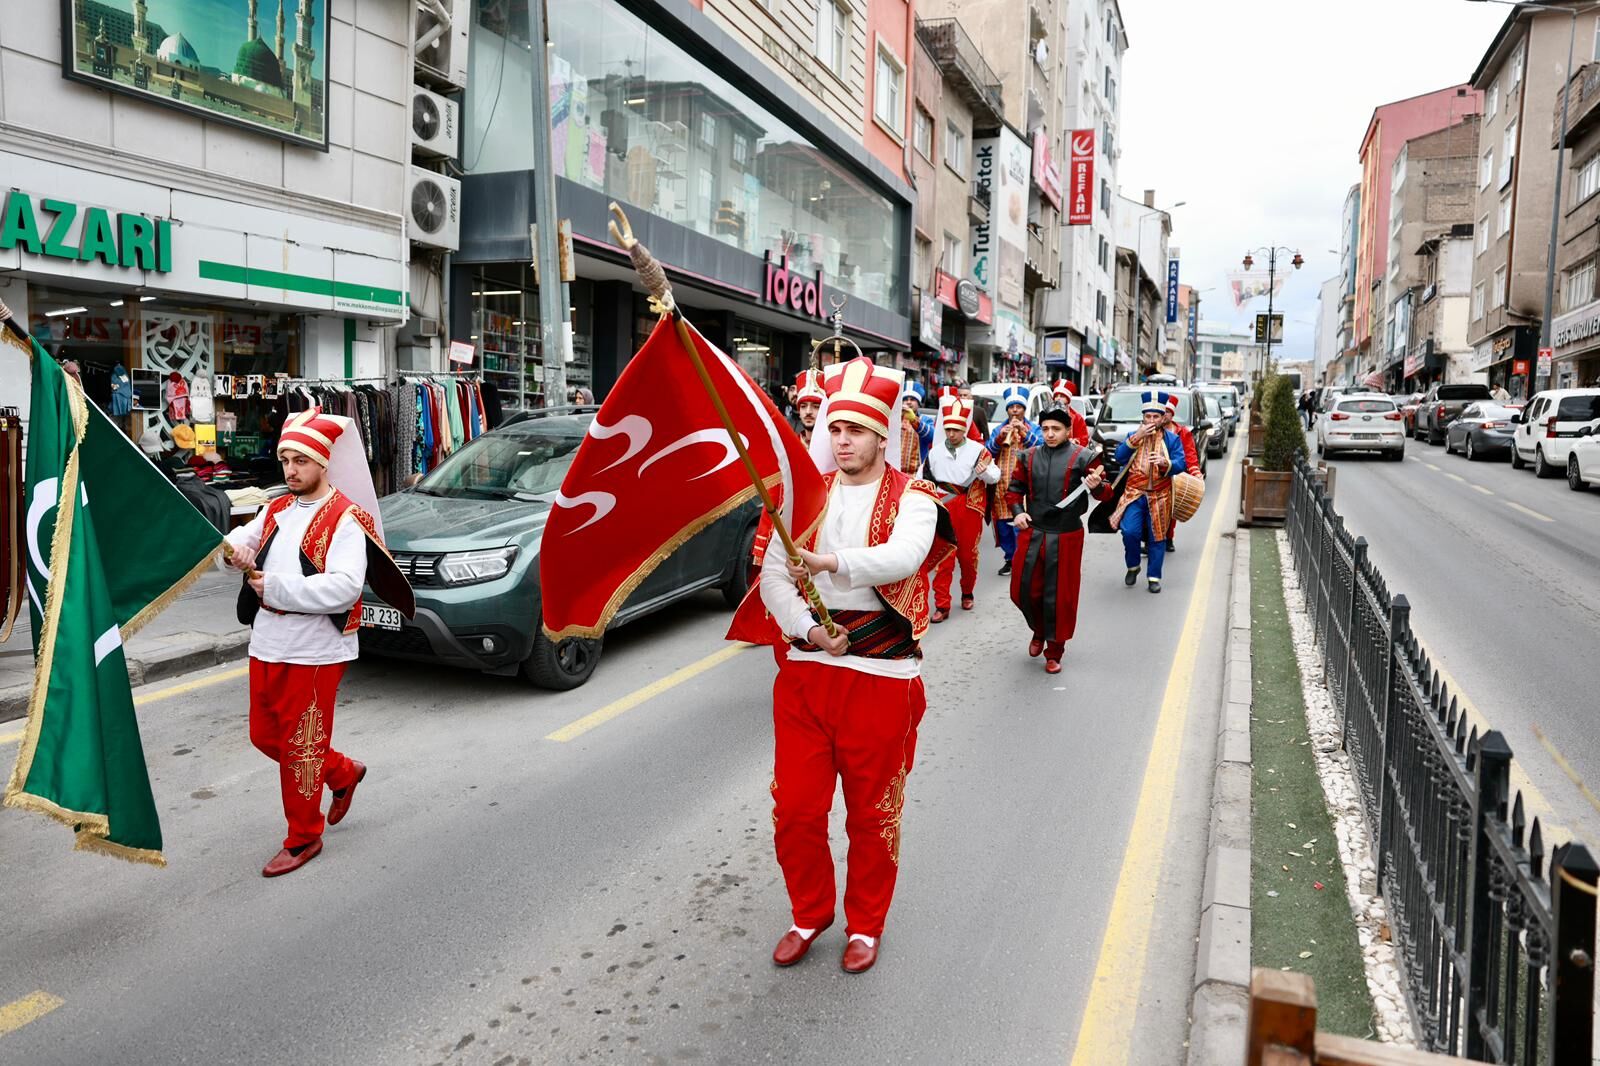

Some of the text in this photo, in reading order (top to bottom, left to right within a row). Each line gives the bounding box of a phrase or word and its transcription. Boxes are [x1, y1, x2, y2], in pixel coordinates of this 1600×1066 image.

[1076, 163, 1087, 213] REFAH
[763, 249, 828, 318] ideal
[362, 606, 399, 625] DR 233
